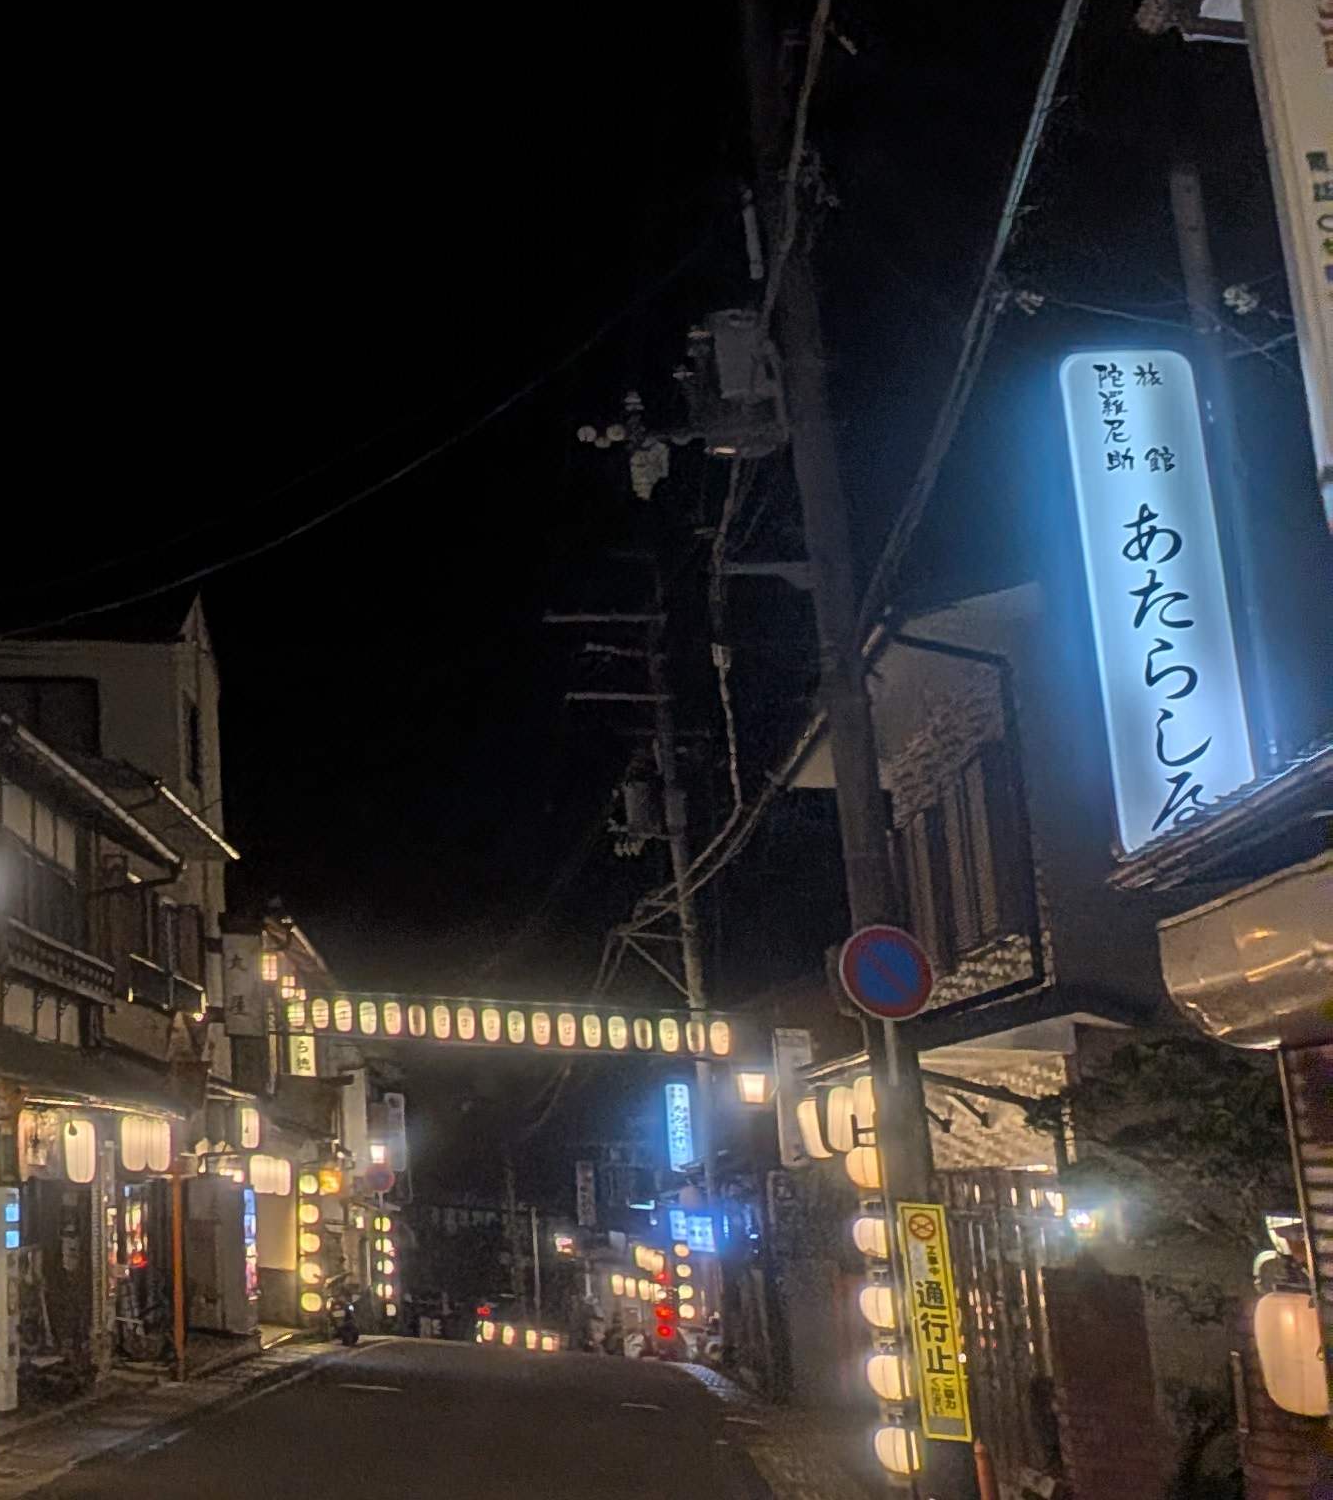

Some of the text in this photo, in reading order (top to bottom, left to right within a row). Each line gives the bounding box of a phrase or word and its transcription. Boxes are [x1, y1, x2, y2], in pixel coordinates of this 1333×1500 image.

[1093, 362, 1134, 471] 陀羅尼助
[1134, 362, 1175, 473] 旅館
[915, 1280, 955, 1375] 通行止
